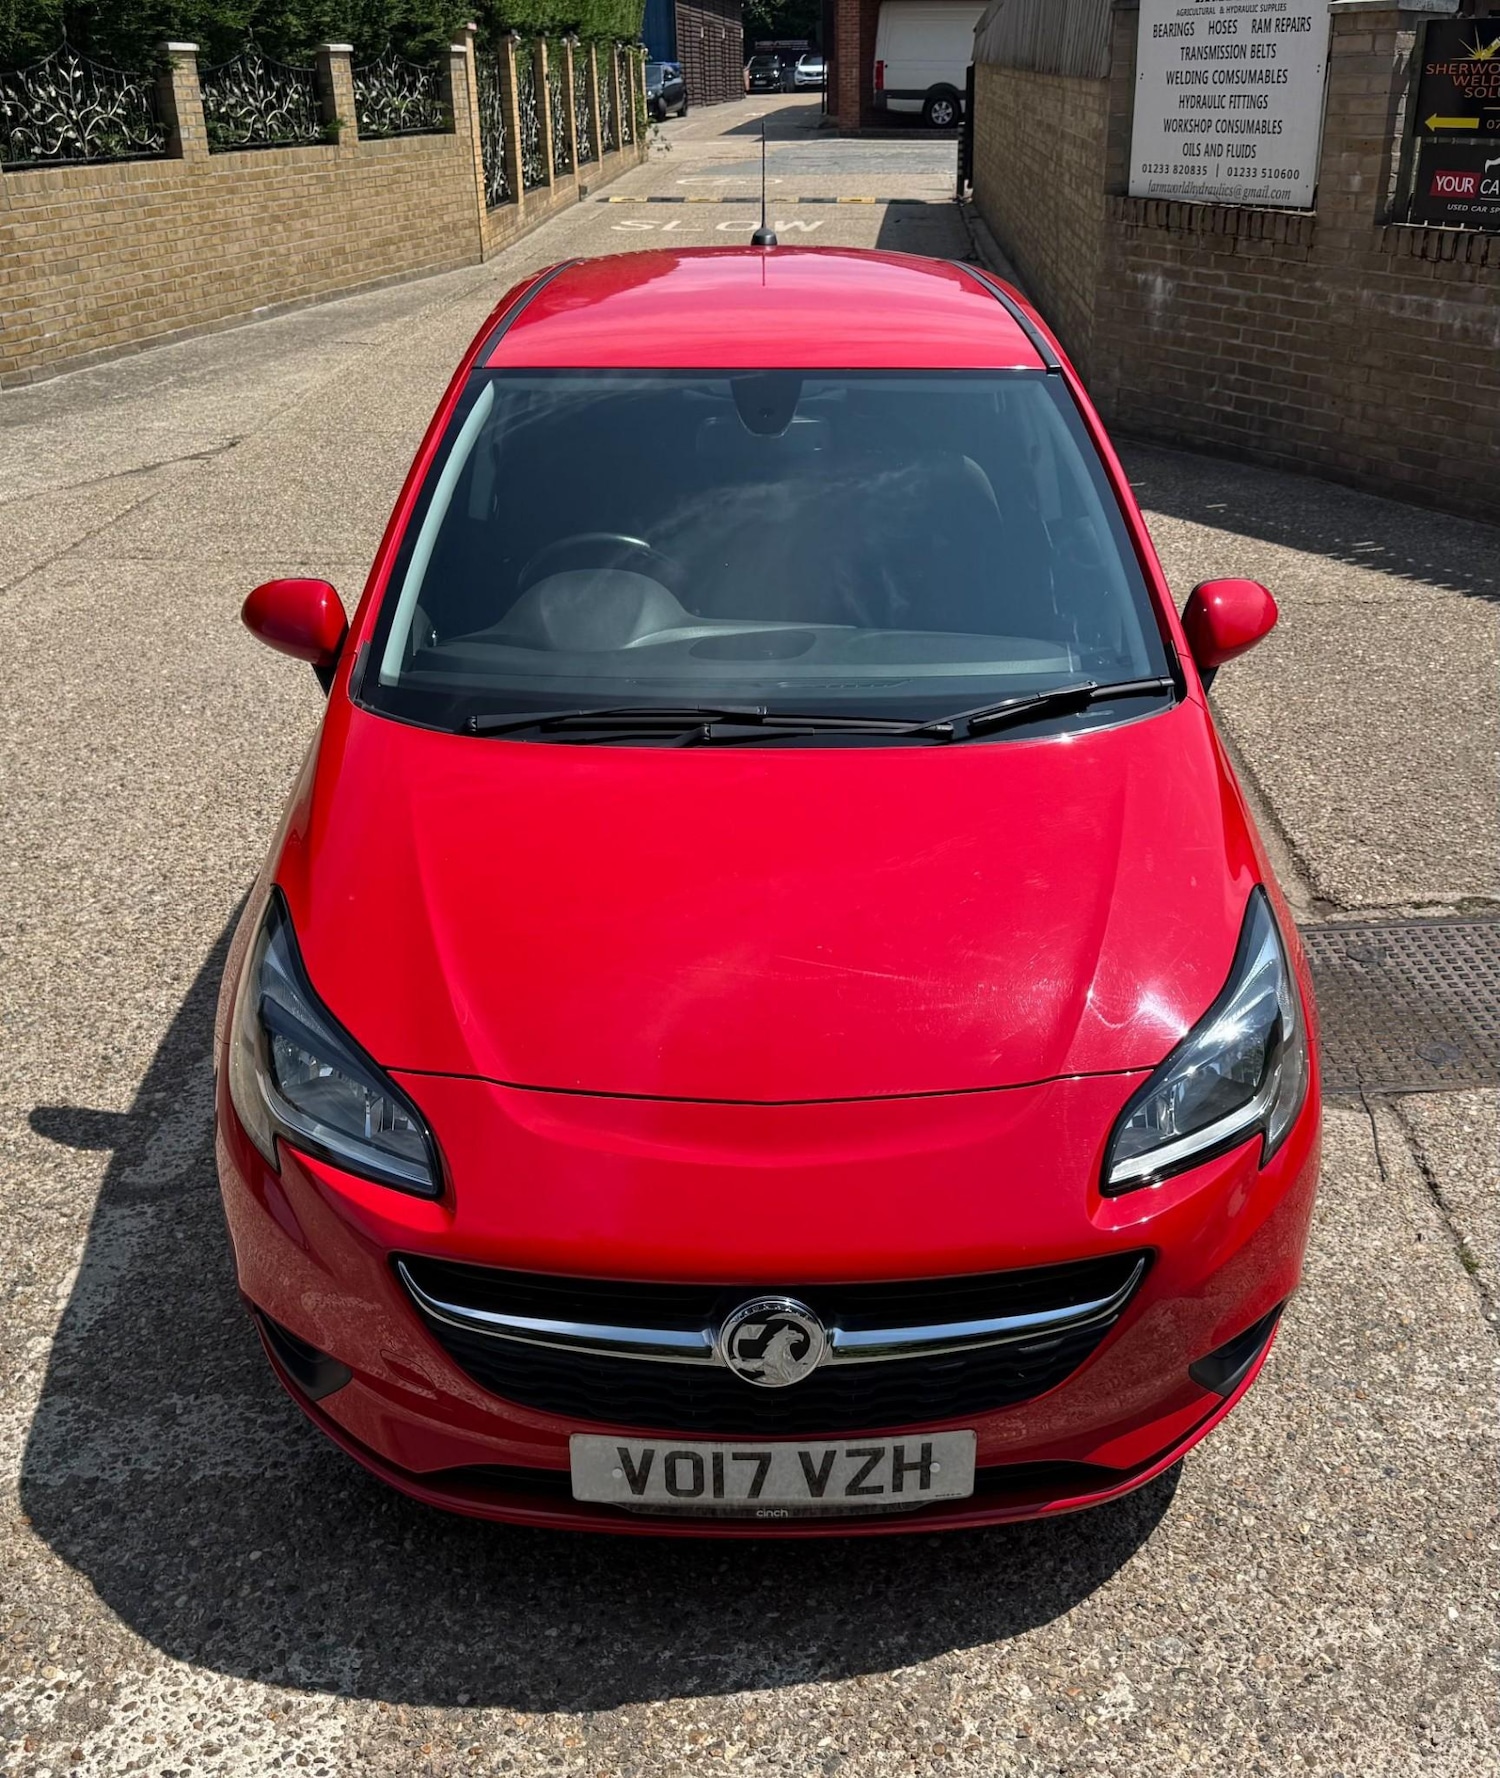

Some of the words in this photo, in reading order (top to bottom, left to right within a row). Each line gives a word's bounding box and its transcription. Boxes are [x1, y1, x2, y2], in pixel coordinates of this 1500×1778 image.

[1176, 6, 1216, 17] AGRICULTURAL
[1226, 4, 1258, 14] HYDRAULIC
[1260, 3, 1288, 13] SUPPLIES
[1153, 21, 1195, 38] BEARINGS
[1208, 19, 1239, 36] HOSES
[1251, 17, 1272, 34] RAM
[1274, 16, 1312, 32] REPAIRS
[1180, 44, 1247, 61] TRANSMISSION
[1250, 43, 1277, 60] BELTS
[1166, 70, 1209, 86] WELDING
[1212, 69, 1288, 85] COMSUMABLES
[1179, 94, 1226, 110] HYDRAULIC
[1229, 95, 1269, 110] FITTINGS
[1163, 118, 1213, 134] WORKSHOP
[1215, 119, 1283, 135] CONSUMABLES
[1182, 142, 1201, 157] OILS
[1203, 143, 1223, 158] AND
[1226, 144, 1257, 159] FLUIDS
[1142, 163, 1170, 175] 01233
[1173, 164, 1208, 176] 820835
[1227, 166, 1258, 178] 01233
[1261, 168, 1300, 180] 510600
[1148, 179, 1291, 202] farmworldhydraulics@gmail.com
[1435, 175, 1474, 194] YOUR
[1447, 203, 1469, 211] USED
[1470, 205, 1487, 213] CAR
[611, 220, 824, 232] SLOW
[616, 1446, 773, 1499] VO17
[798, 1443, 933, 1498] VZH
[756, 1508, 789, 1518] cinch
